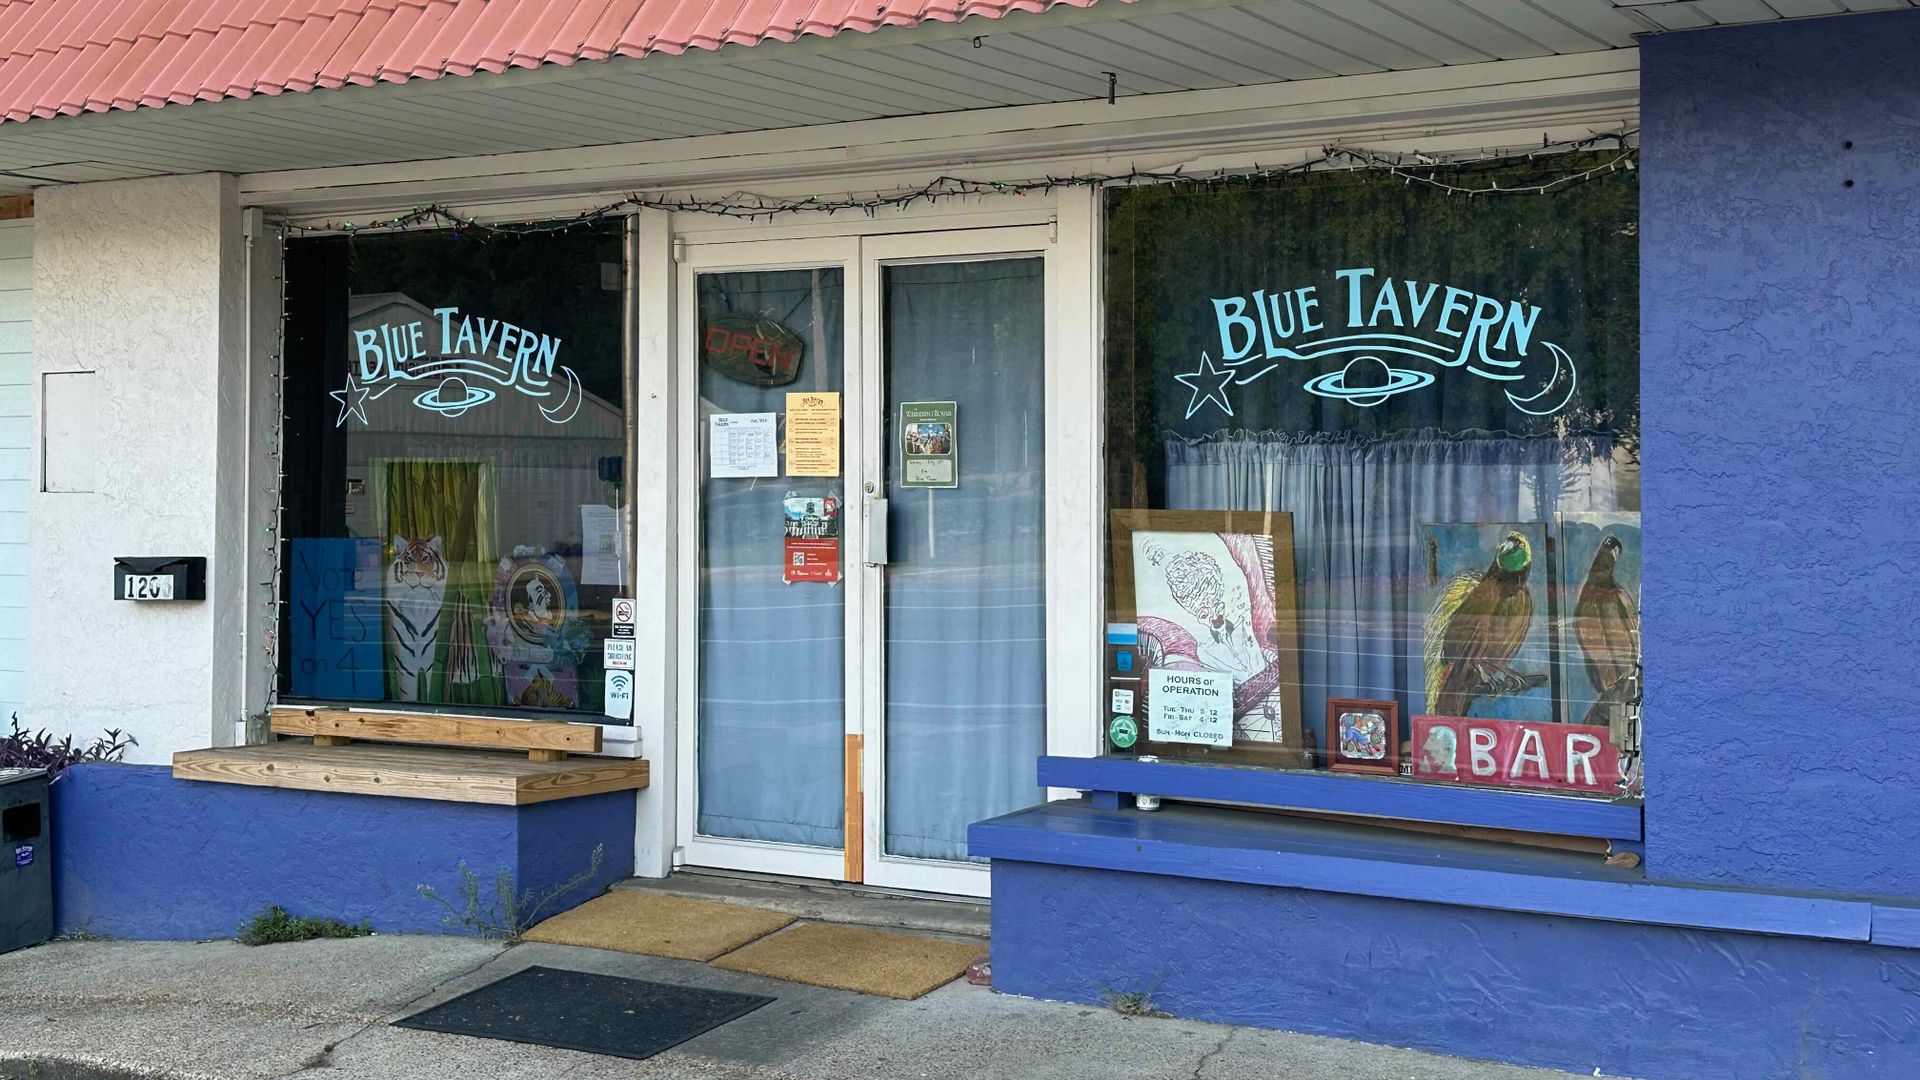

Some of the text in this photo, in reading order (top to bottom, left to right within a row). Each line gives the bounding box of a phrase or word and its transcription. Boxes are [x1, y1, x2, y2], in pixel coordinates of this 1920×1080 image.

[1210, 267, 1542, 368] BLUE TAVERN
[353, 306, 562, 387] BLUE TAVERN
[705, 327, 796, 372] OPEN
[299, 598, 368, 643] YES
[335, 646, 361, 694] 4
[1162, 685, 1219, 697] OPERATION
[1166, 675, 1202, 686] HOURS
[1468, 727, 1602, 786] BAR
